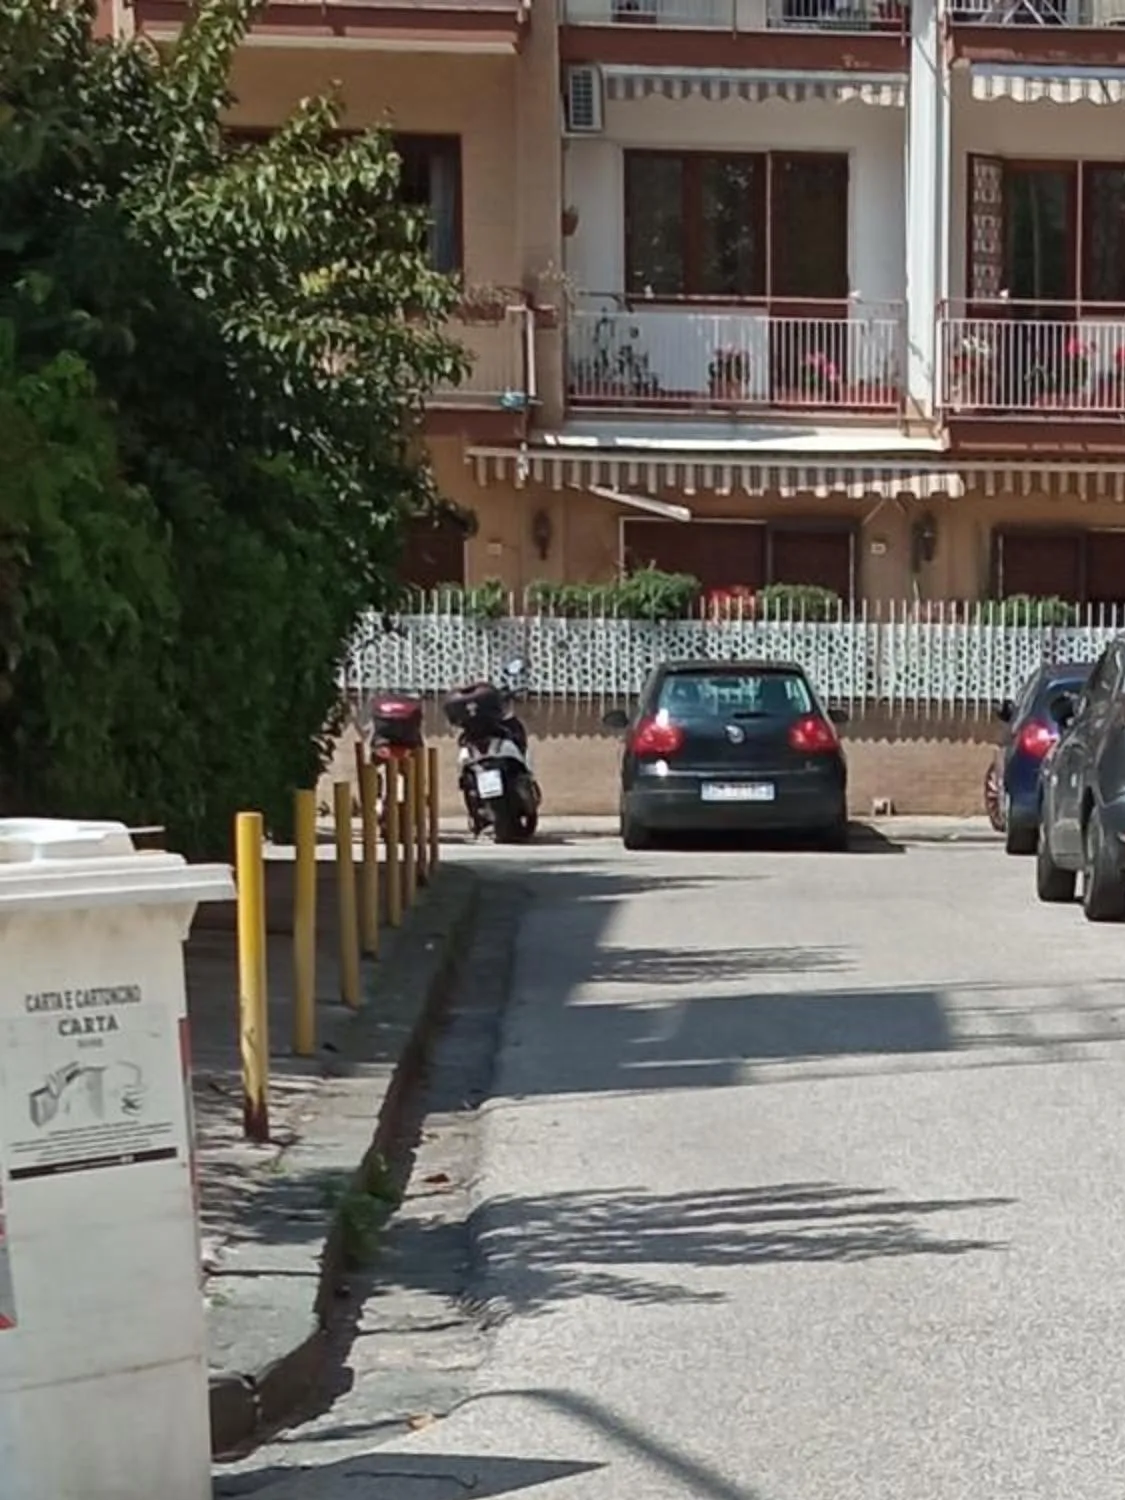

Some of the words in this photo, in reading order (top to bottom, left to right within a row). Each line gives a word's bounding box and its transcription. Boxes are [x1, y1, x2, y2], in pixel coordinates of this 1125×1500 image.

[25, 990, 63, 1013] CARTA
[64, 990, 73, 1011] E
[57, 1014, 119, 1037] CARTA
